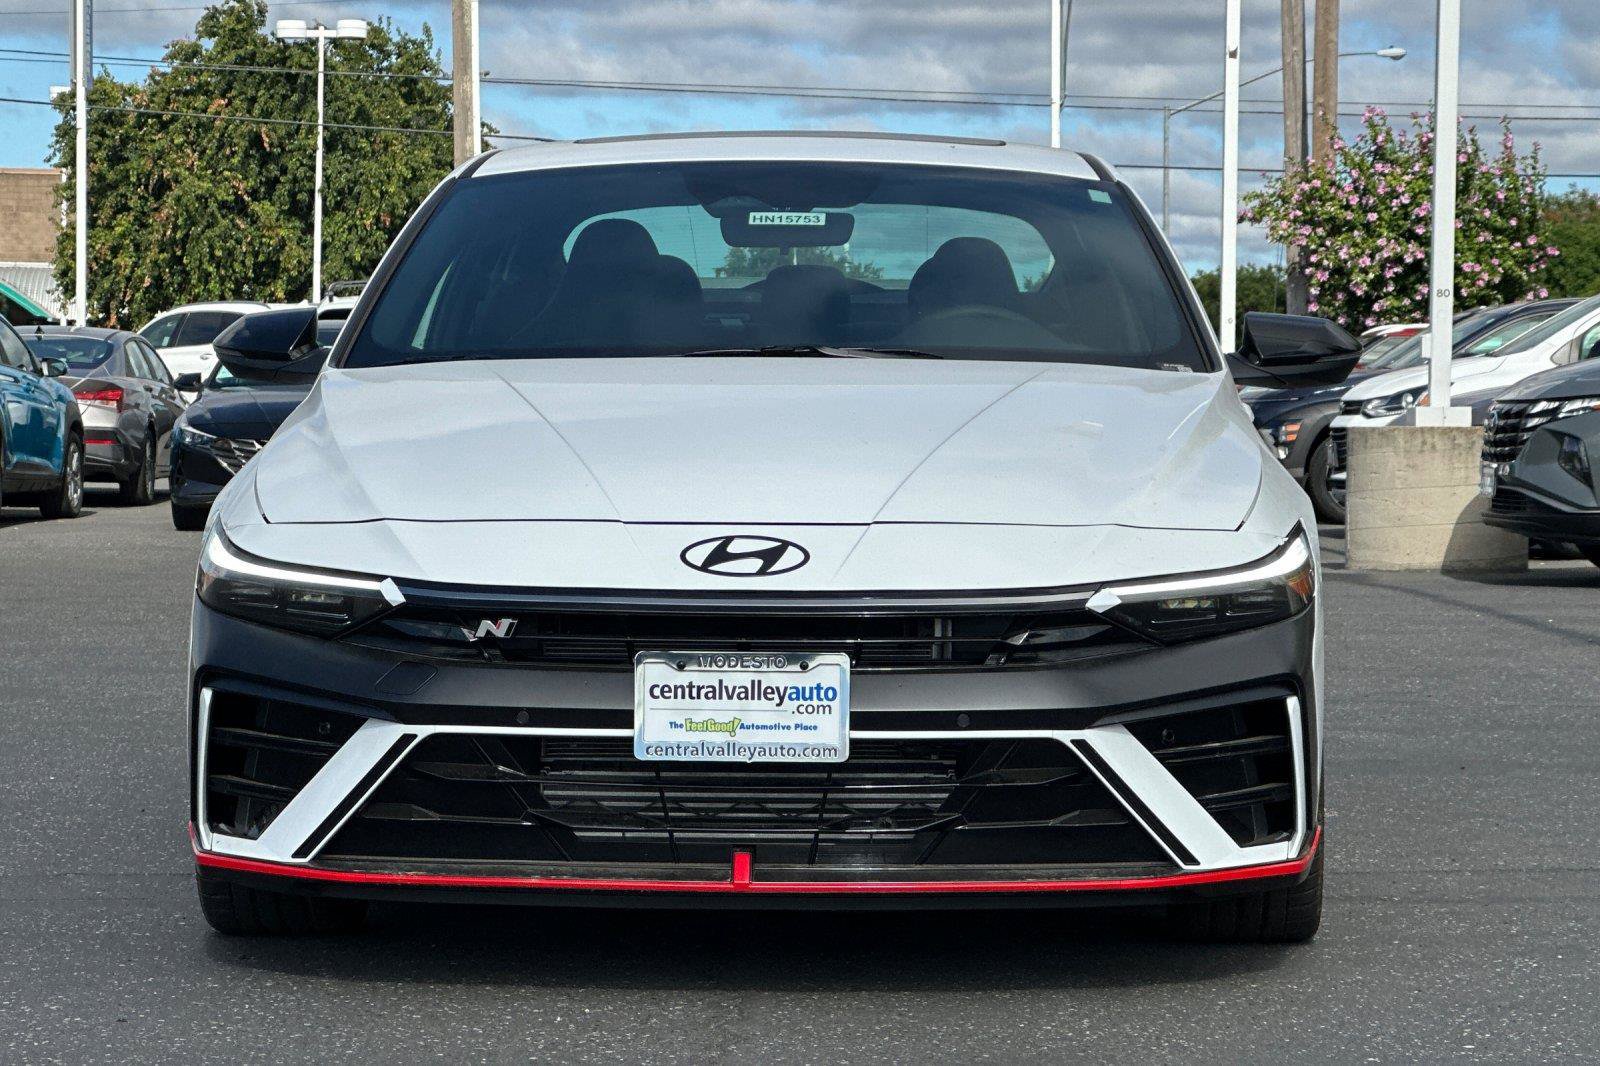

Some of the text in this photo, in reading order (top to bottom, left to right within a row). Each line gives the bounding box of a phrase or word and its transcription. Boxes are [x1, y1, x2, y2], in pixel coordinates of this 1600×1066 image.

[752, 214, 821, 224] HN15753
[1436, 288, 1451, 298] 80
[697, 655, 788, 669] MODESTO
[649, 679, 838, 707] centralvalleyauto
[791, 703, 833, 715] .com
[669, 721, 684, 729] The
[739, 722, 792, 731] Automotive
[794, 723, 818, 731] Place
[645, 740, 839, 761] centralvalleyauto.com
